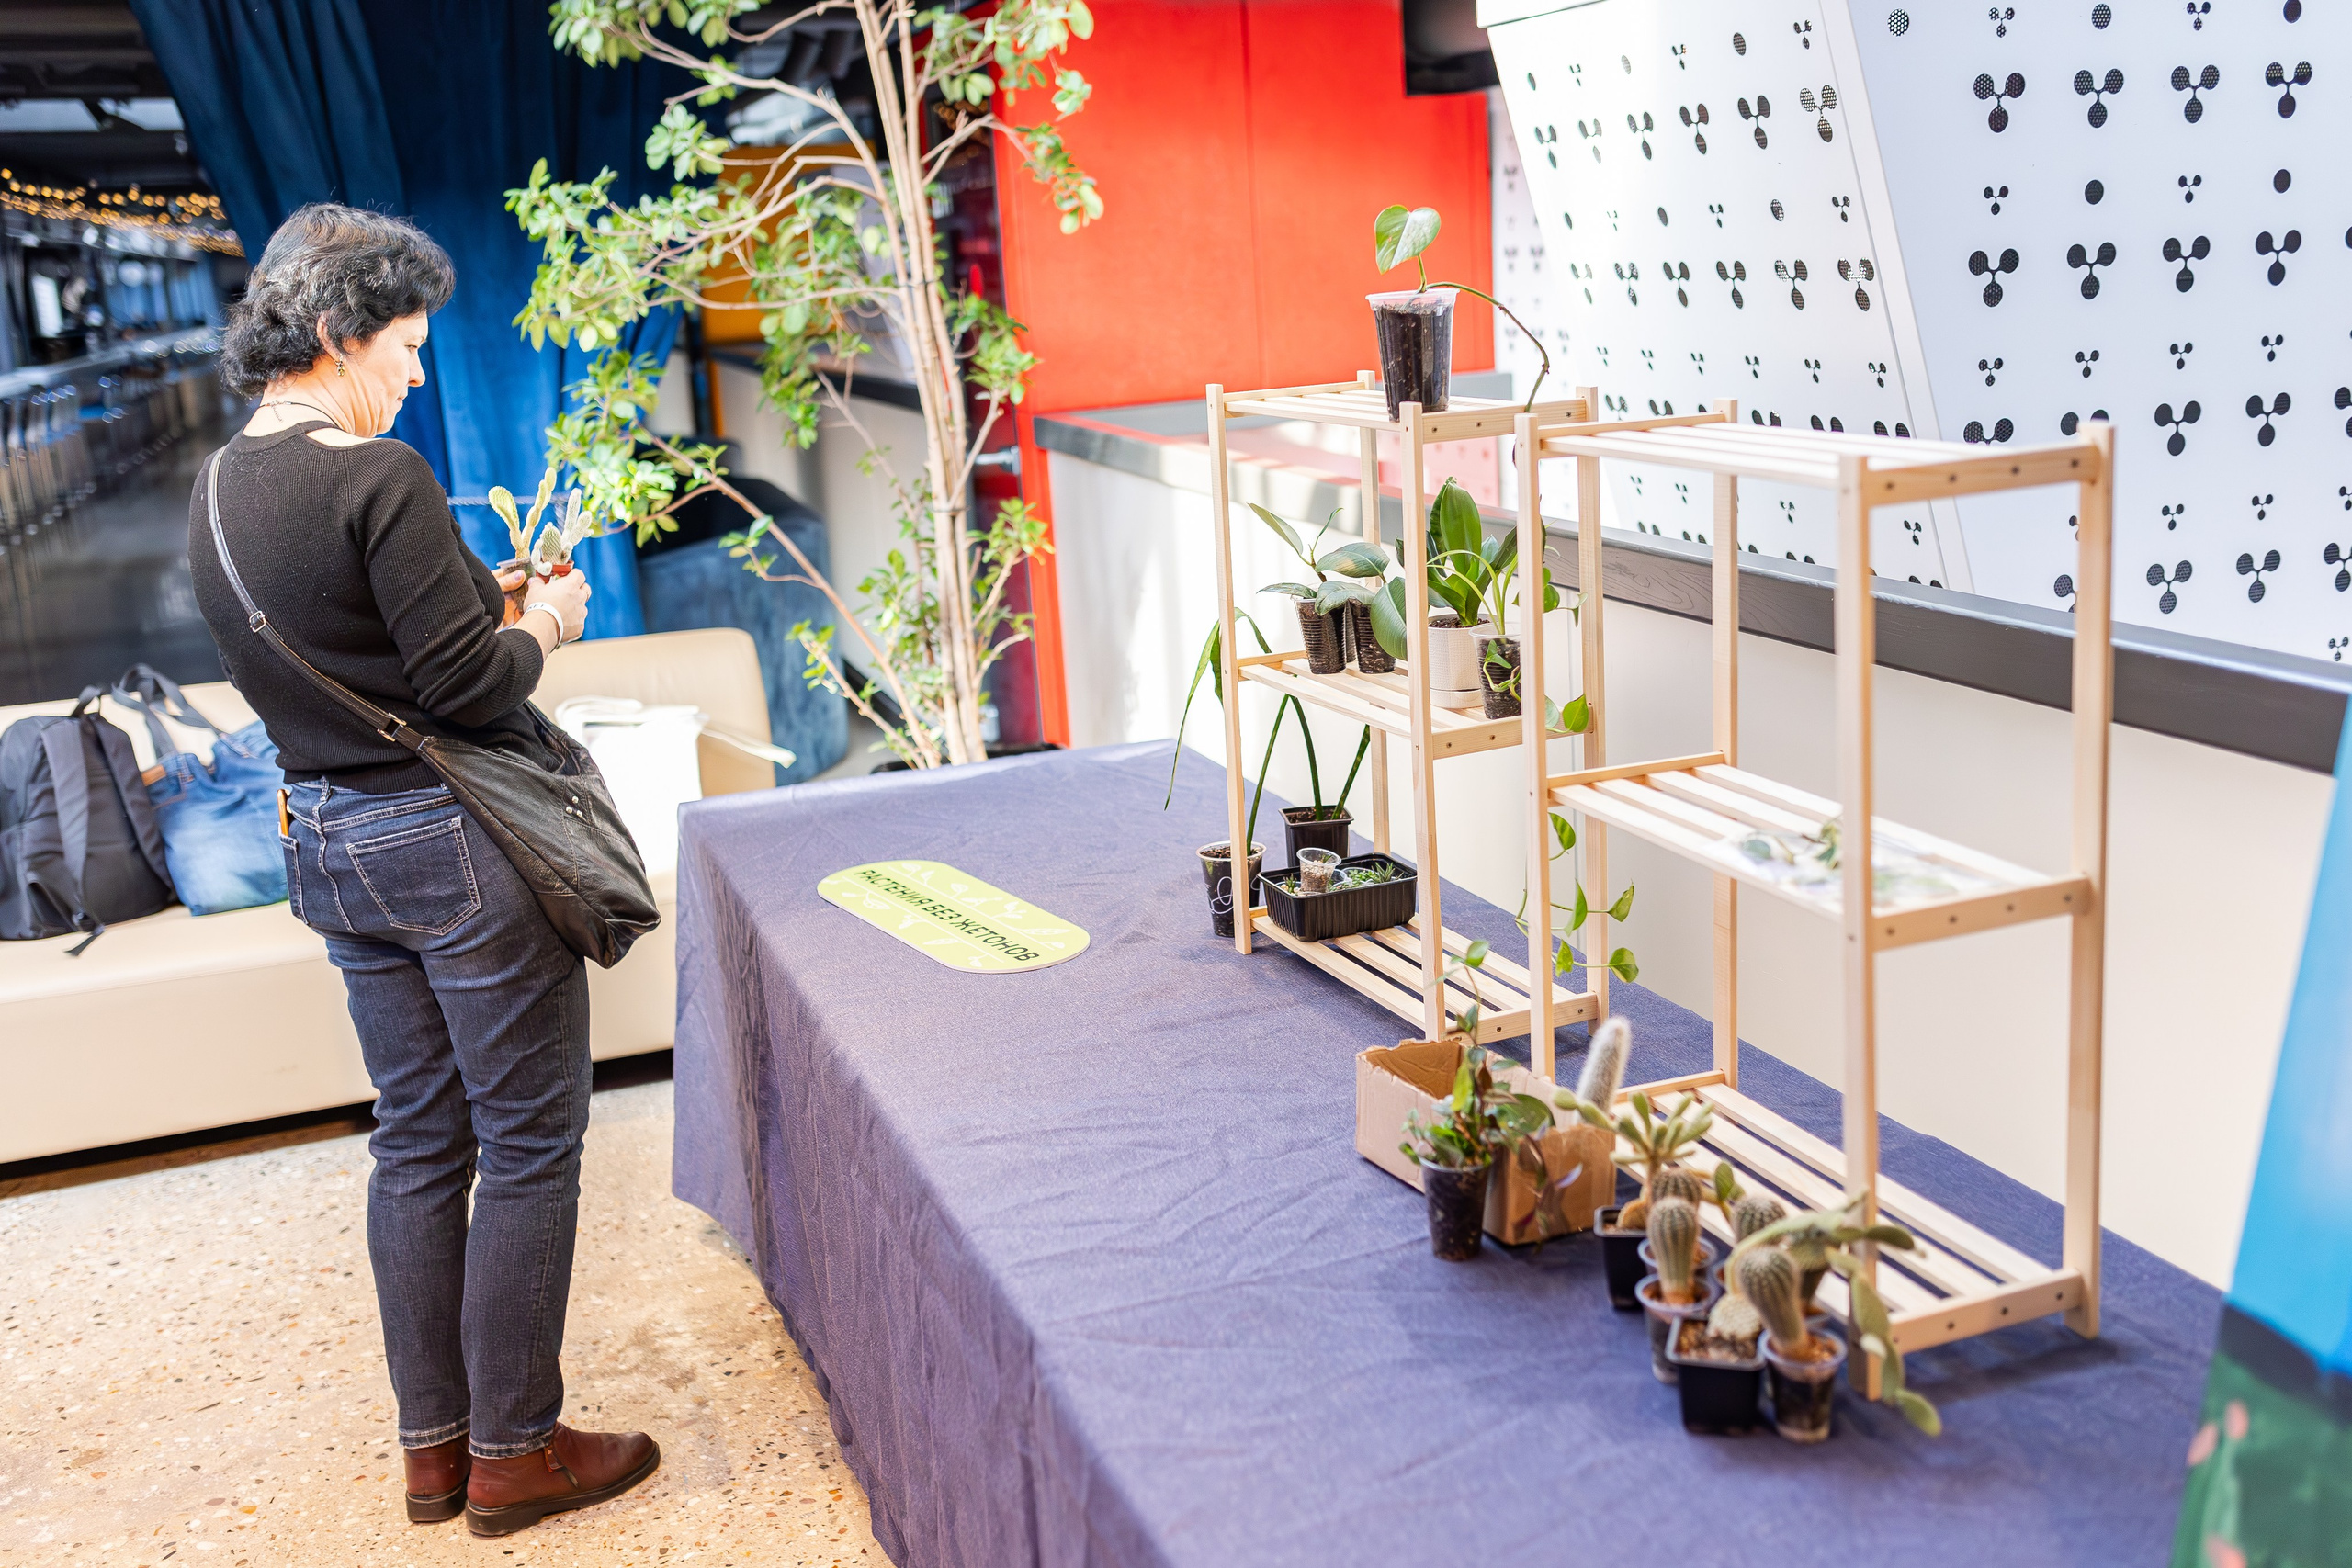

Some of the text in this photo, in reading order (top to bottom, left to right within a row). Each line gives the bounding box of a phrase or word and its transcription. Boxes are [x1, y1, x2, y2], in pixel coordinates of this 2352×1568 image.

[854, 869, 1040, 962] РАСТЕНИЯ БЕЗ ЖЕТОНОВ
